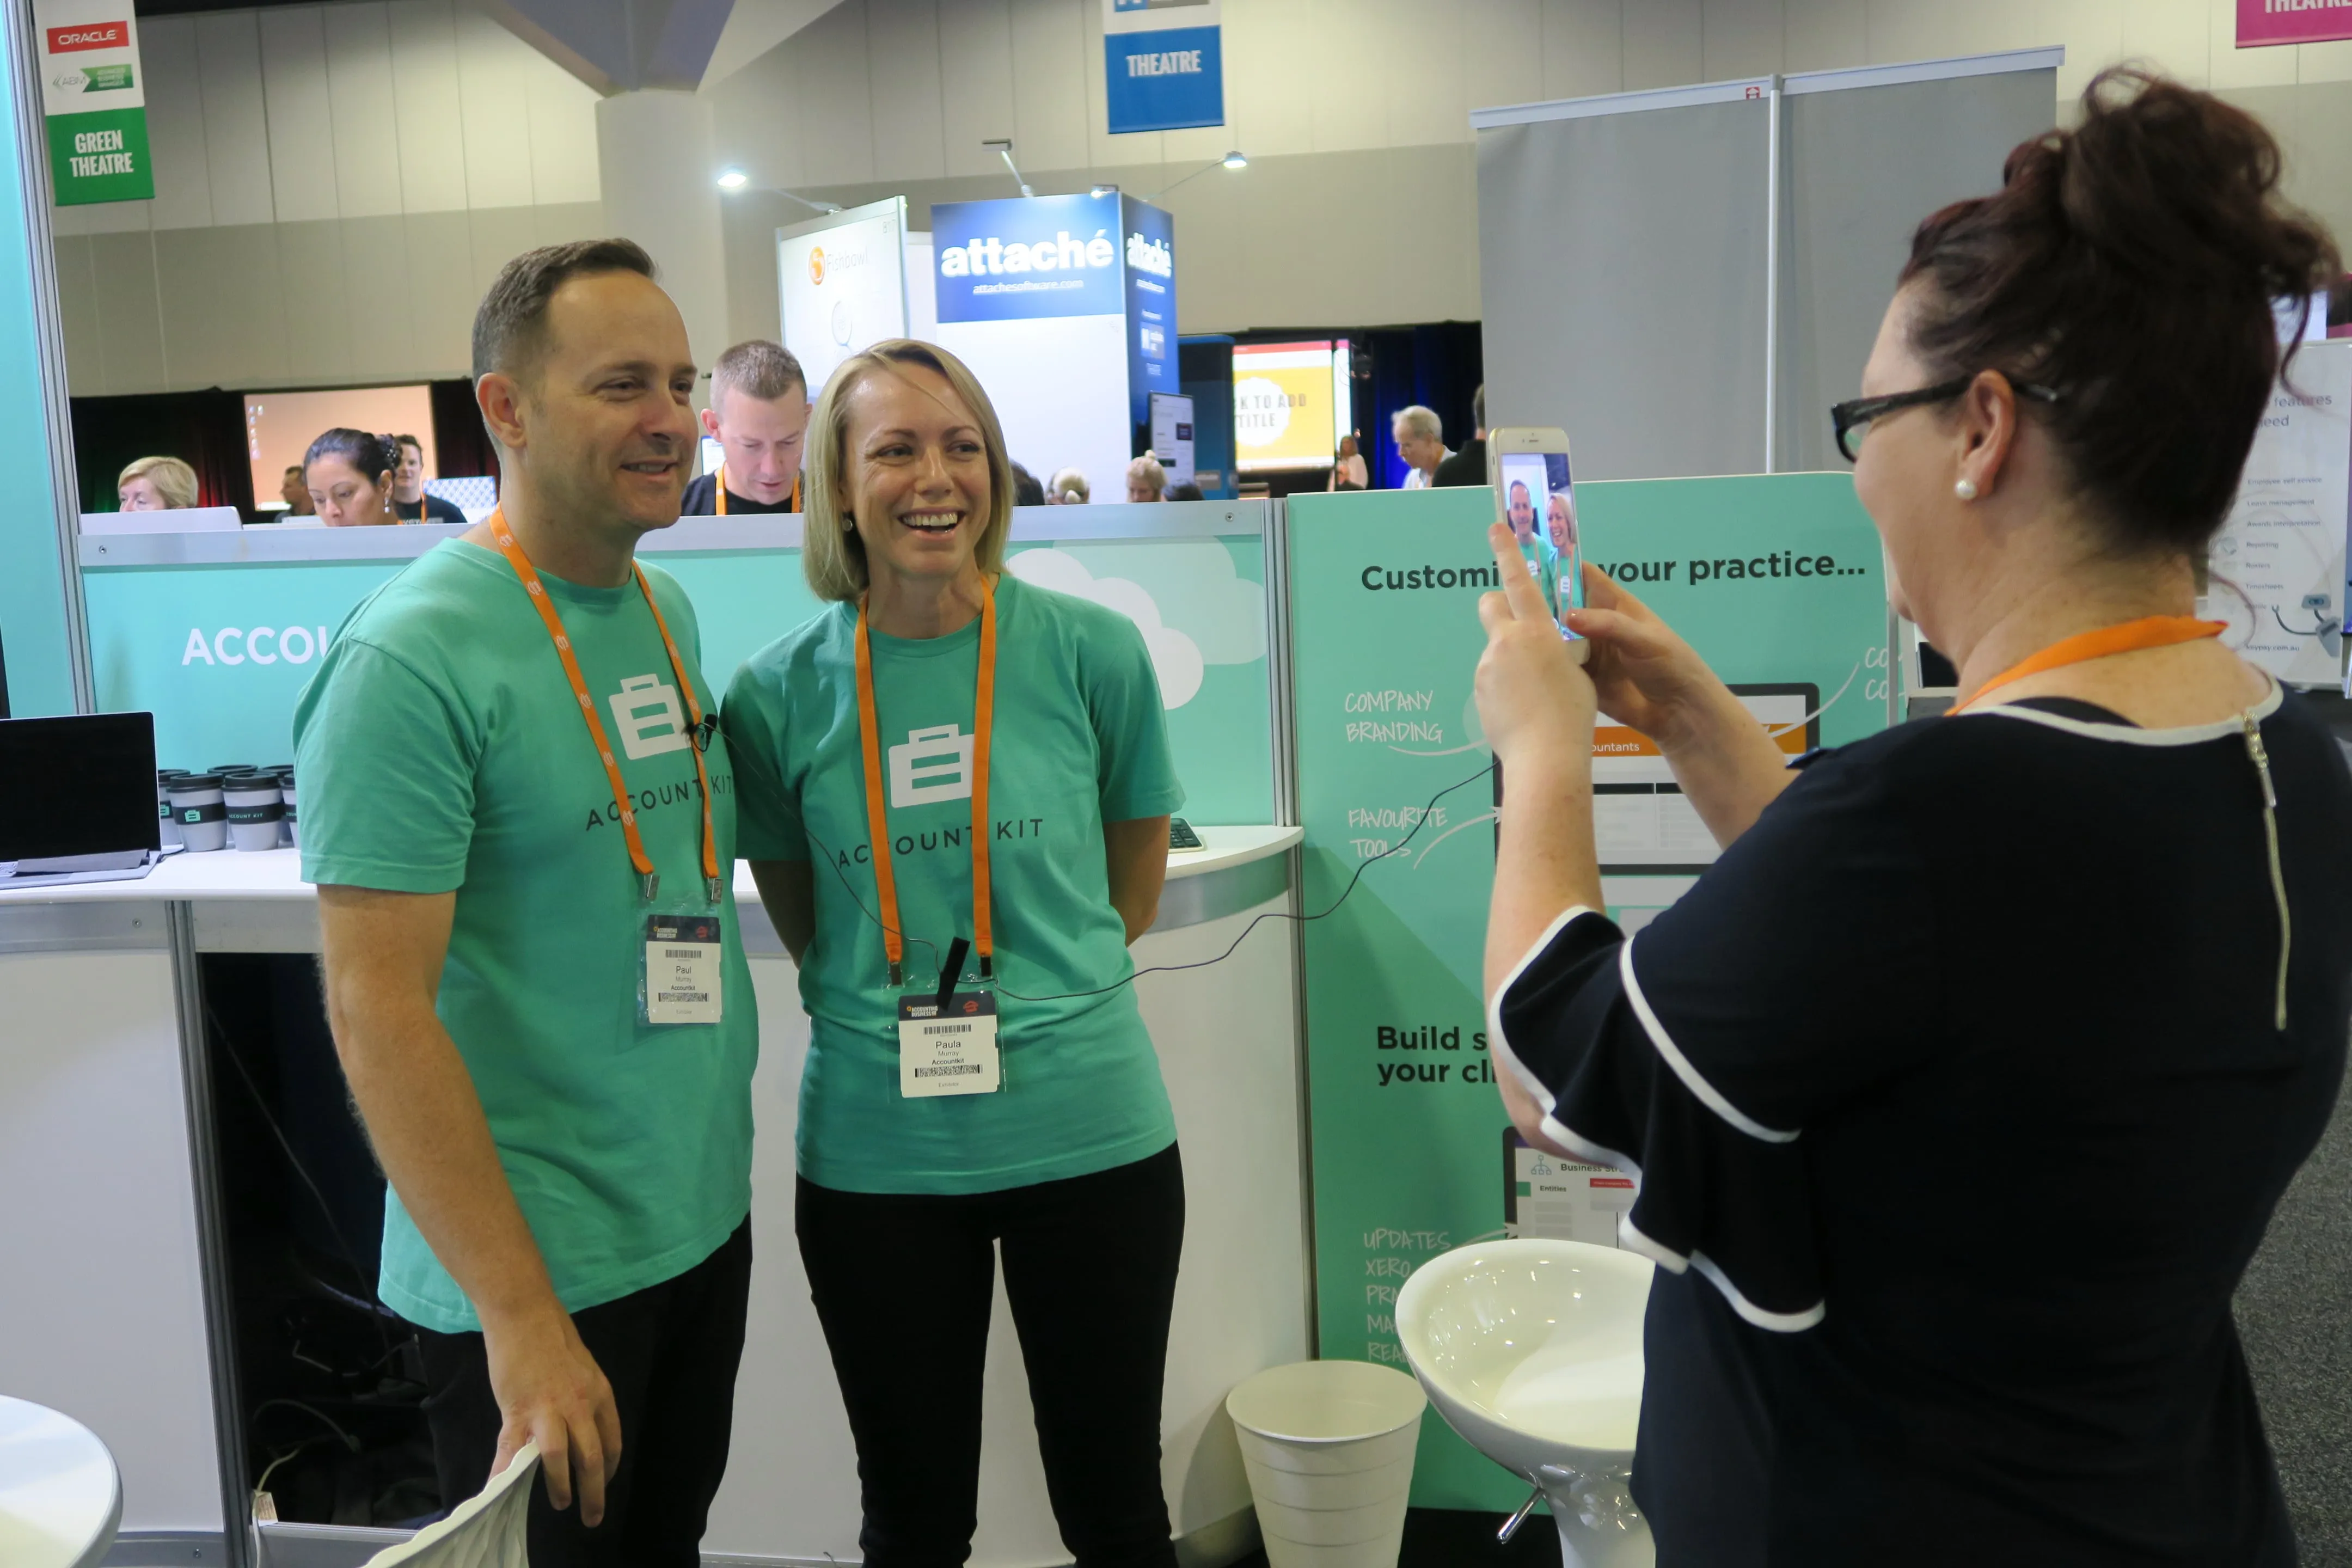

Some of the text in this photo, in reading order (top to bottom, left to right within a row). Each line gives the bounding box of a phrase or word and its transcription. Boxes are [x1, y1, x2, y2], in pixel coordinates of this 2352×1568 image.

[58, 29, 117, 45] ORACLE
[1125, 50, 1202, 77] THEATRE
[75, 130, 123, 154] GREEN
[70, 152, 134, 177] THEATRE
[826, 246, 868, 272] Fishbowl
[941, 229, 1114, 278] attaché
[972, 279, 1085, 295] attachesoftware.com
[1254, 395, 1272, 409] TO
[1278, 393, 1307, 408] ADD
[1235, 412, 1276, 428] TITLE
[1361, 560, 1499, 591] Customi
[1689, 550, 1865, 586] practice...
[1345, 690, 1433, 713] COMPANY
[1346, 720, 1443, 744] BRANDING
[710, 775, 731, 795] KIT
[1349, 806, 1448, 831] FAVOURITE
[838, 818, 1043, 869] ACOUN KIT
[1350, 838, 1412, 859] TOOLS
[676, 965, 691, 975] Paul
[935, 1040, 961, 1049] Paula
[1377, 1026, 1460, 1051] Build
[1376, 1063, 1450, 1087] your
[1560, 1163, 1602, 1172] Business
[1363, 1228, 1452, 1251] UPDATES
[1365, 1258, 1411, 1278] XERO
[1367, 1313, 1399, 1335] MA
